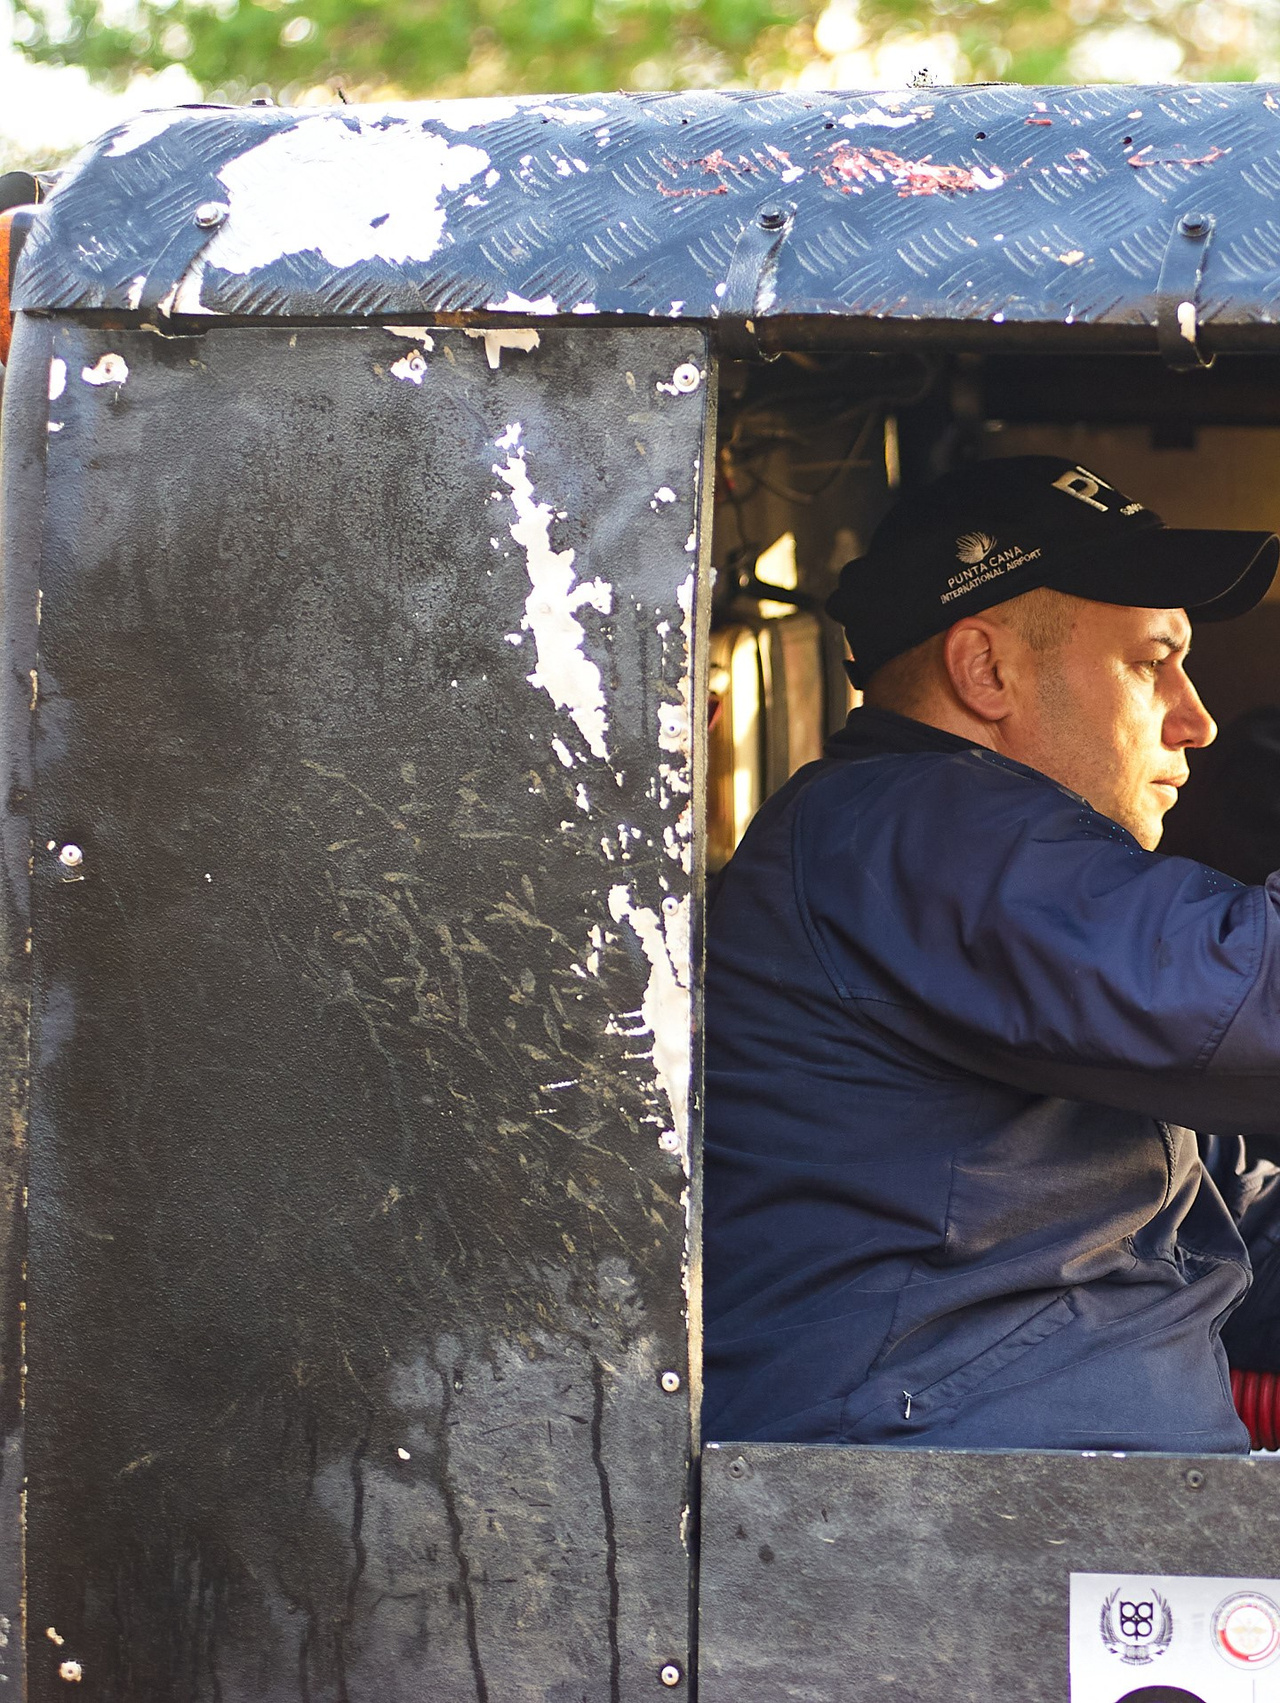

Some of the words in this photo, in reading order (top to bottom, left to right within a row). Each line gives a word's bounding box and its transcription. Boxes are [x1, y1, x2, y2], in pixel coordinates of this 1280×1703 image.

[940, 566, 1005, 604] INTERNATIONAL
[1006, 547, 1042, 572] AIRPORT
[947, 562, 988, 589] PUNTA
[988, 545, 1024, 567] CANA
